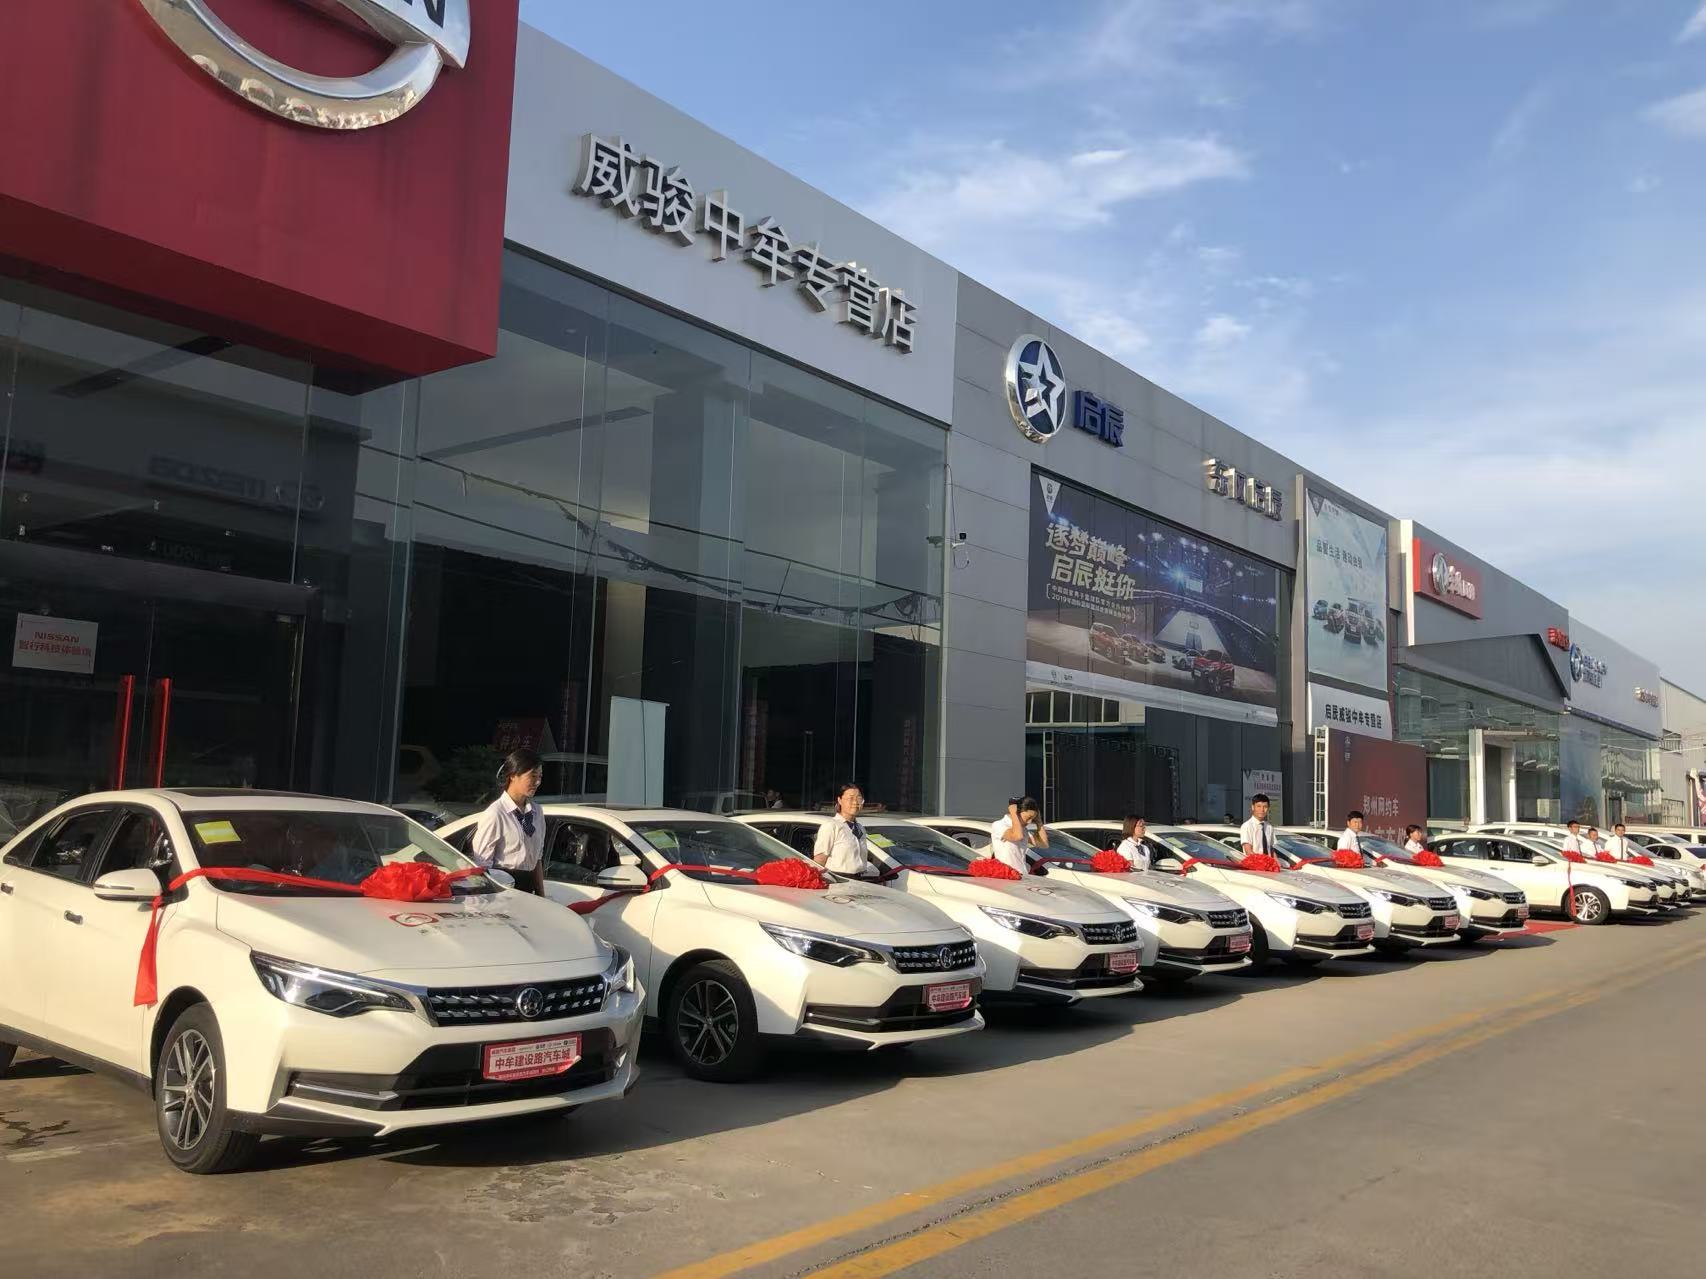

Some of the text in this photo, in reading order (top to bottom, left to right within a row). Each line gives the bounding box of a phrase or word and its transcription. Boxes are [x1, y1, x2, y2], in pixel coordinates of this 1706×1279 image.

[572, 133, 917, 354] 威骏中牟专营店
[1073, 390, 1125, 448] 启辰
[1207, 457, 1283, 522] 东风启辰
[1046, 522, 1128, 571] 逐梦巅峰
[1051, 554, 1136, 601] 启辰挺你
[34, 632, 80, 643] NISSAN
[1325, 703, 1382, 729] 启辰威骏中牟专营店
[1363, 795, 1399, 817] 郑州网约车
[495, 1048, 571, 1070] 中牟建设路汽车城
